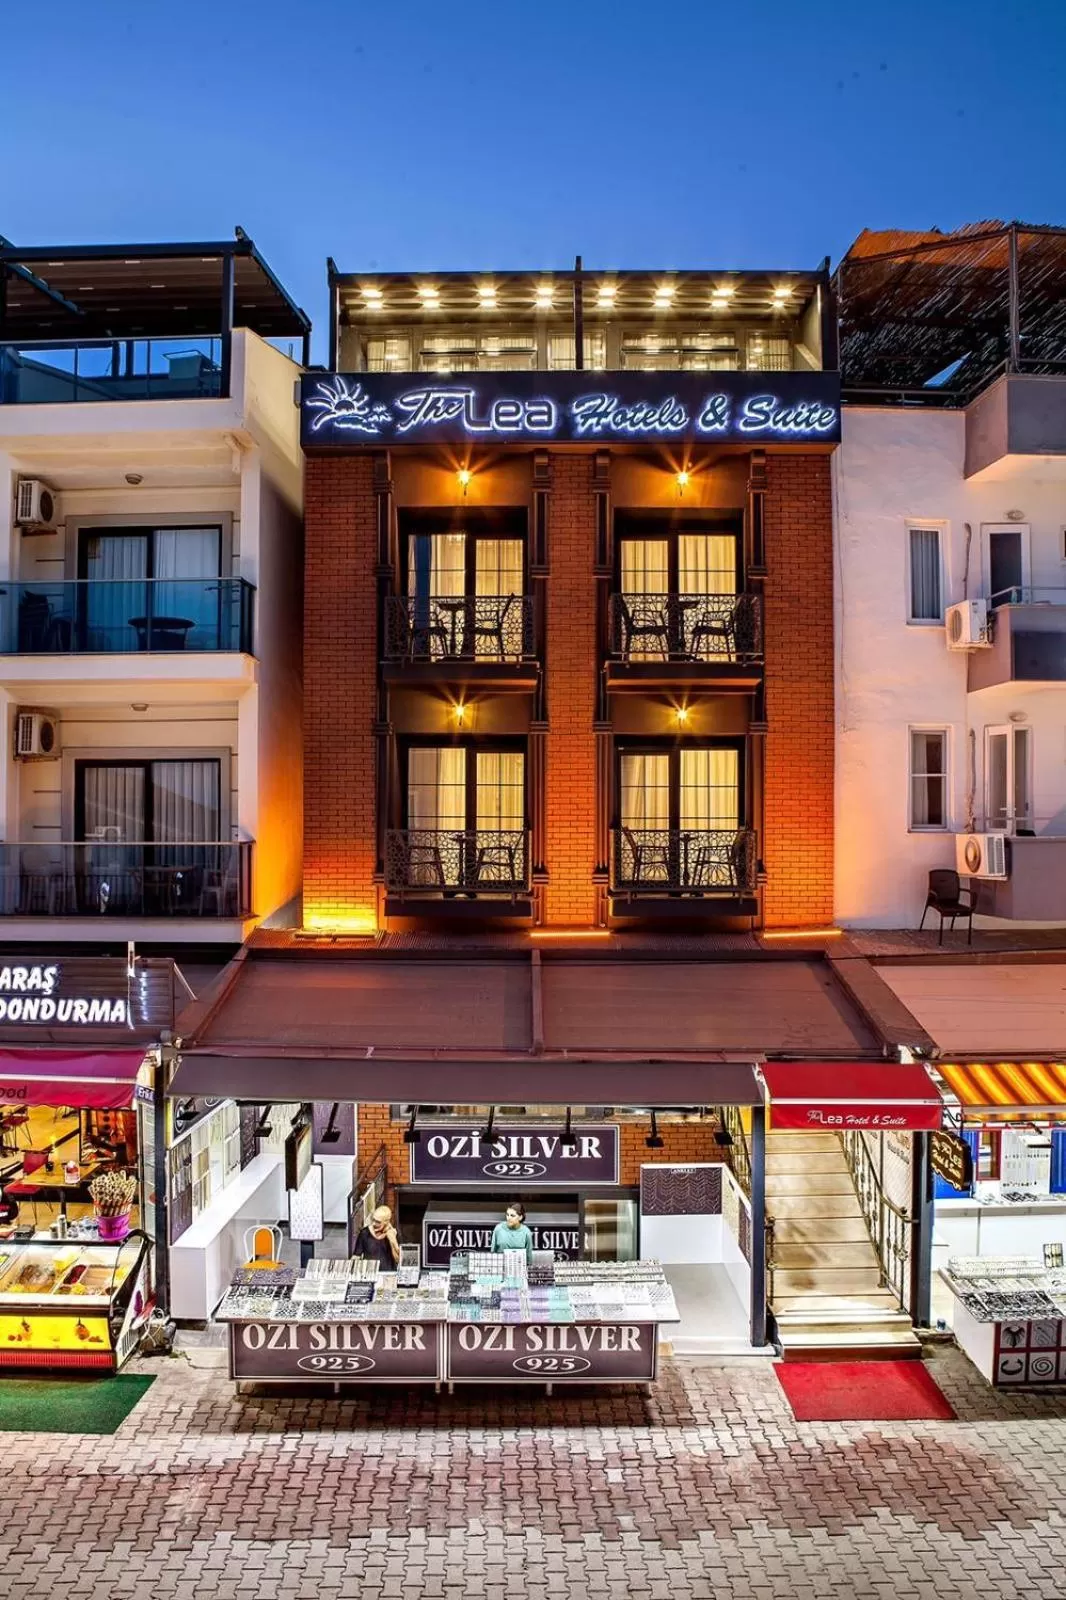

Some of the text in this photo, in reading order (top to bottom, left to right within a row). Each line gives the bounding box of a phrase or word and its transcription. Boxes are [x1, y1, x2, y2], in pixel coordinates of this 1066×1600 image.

[396, 387, 836, 434] The Lea Hotels & Suite
[820, 1110, 843, 1124] Lea
[846, 1115, 870, 1124] Hotel
[872, 1115, 879, 1124] &
[880, 1115, 907, 1125] Suite
[427, 1131, 602, 1159] OZİ SILVER
[494, 1163, 535, 1175] 925
[429, 1225, 494, 1249] OZİ SILVE
[309, 1324, 426, 1351] SILVER
[525, 1325, 642, 1352] SILVER
[310, 1357, 360, 1370] 925
[526, 1357, 575, 1371] 925
